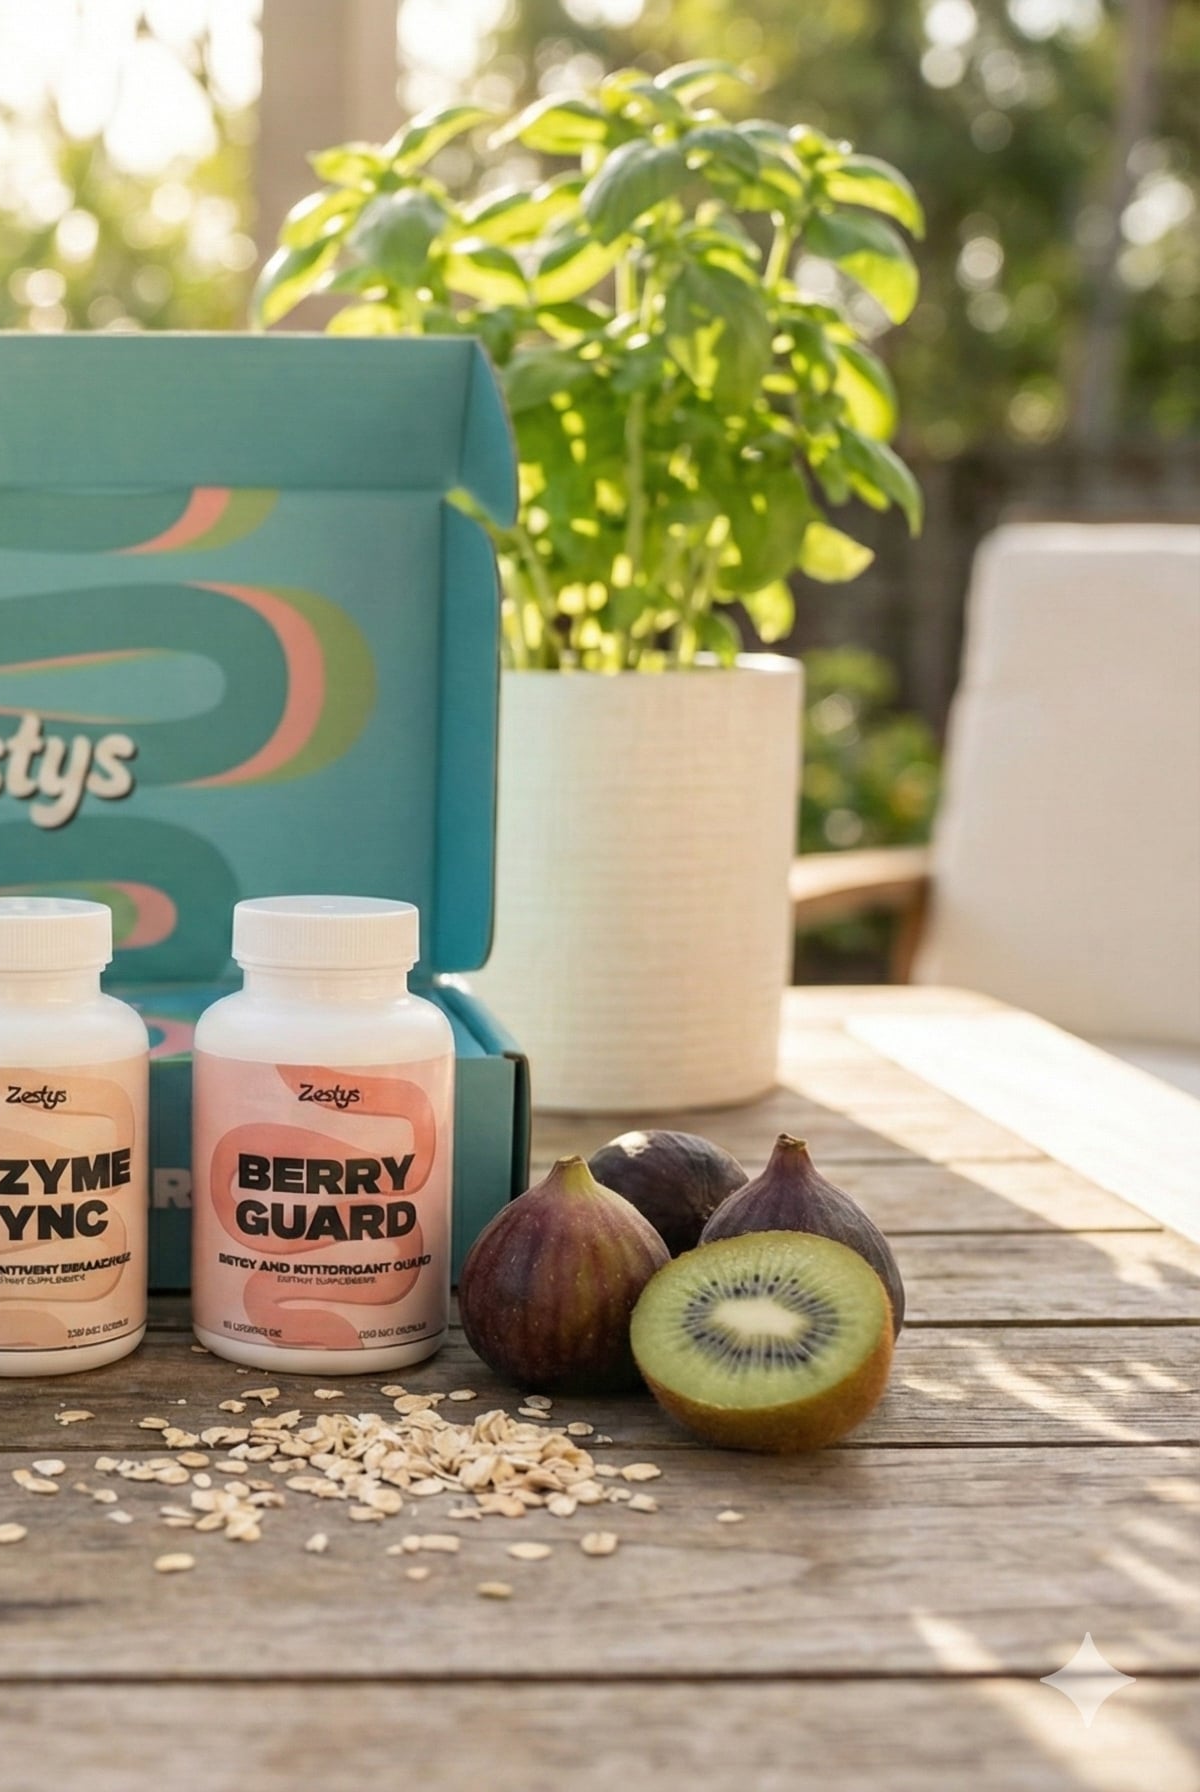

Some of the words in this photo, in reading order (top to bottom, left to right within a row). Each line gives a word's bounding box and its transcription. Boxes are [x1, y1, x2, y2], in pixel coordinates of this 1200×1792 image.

[5, 1085, 67, 1110] Zestys
[298, 1084, 361, 1108] Zestys
[238, 1153, 416, 1195] BERRY
[235, 1199, 417, 1241] GUARD
[259, 1260, 290, 1274] AND
